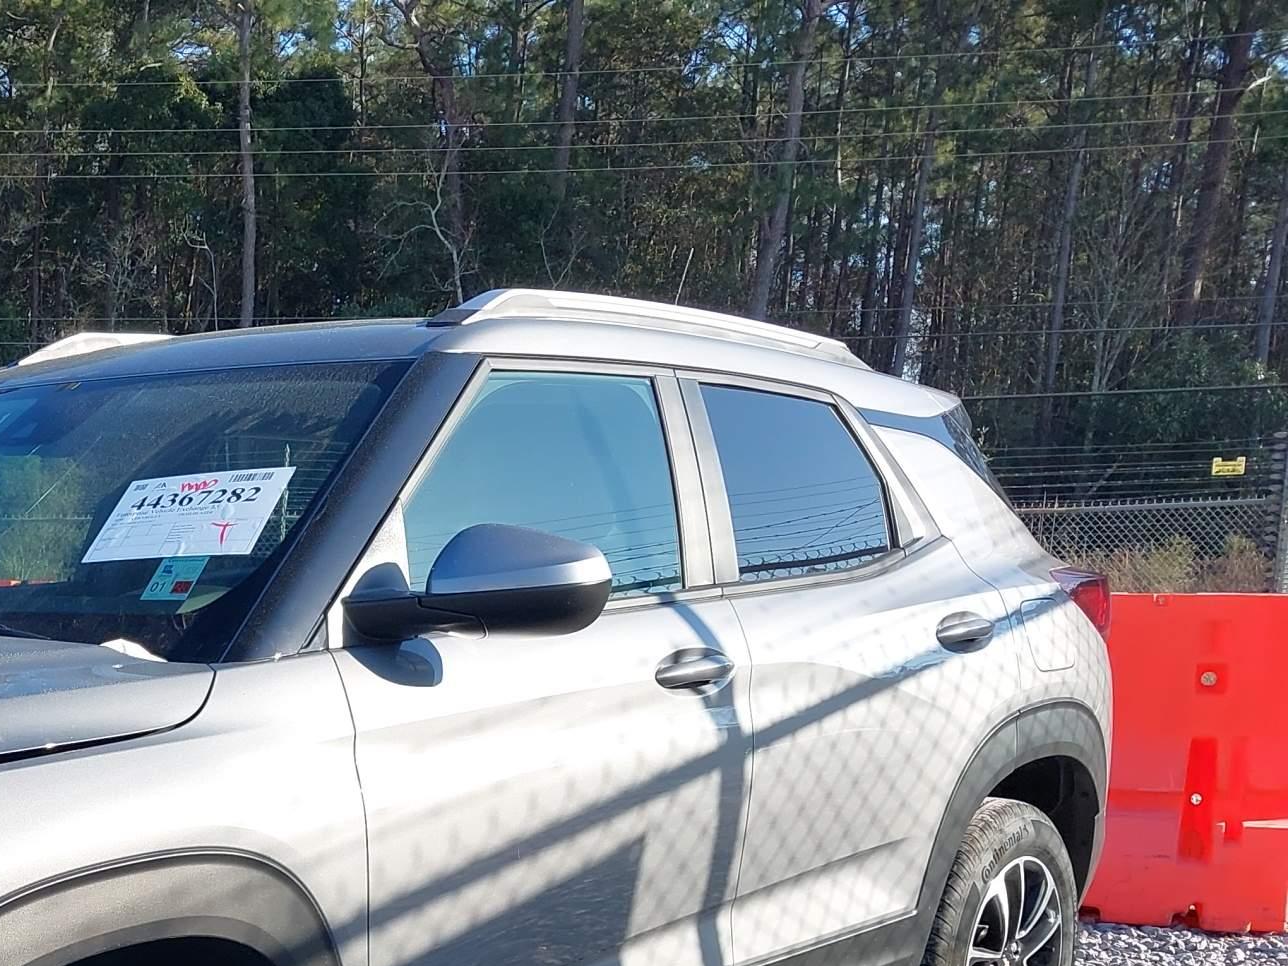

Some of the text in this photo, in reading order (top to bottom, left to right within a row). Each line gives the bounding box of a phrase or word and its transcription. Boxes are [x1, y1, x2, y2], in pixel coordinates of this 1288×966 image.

[131, 486, 261, 511] 44367282
[149, 580, 166, 593] 01
[981, 825, 1024, 884] Continental
